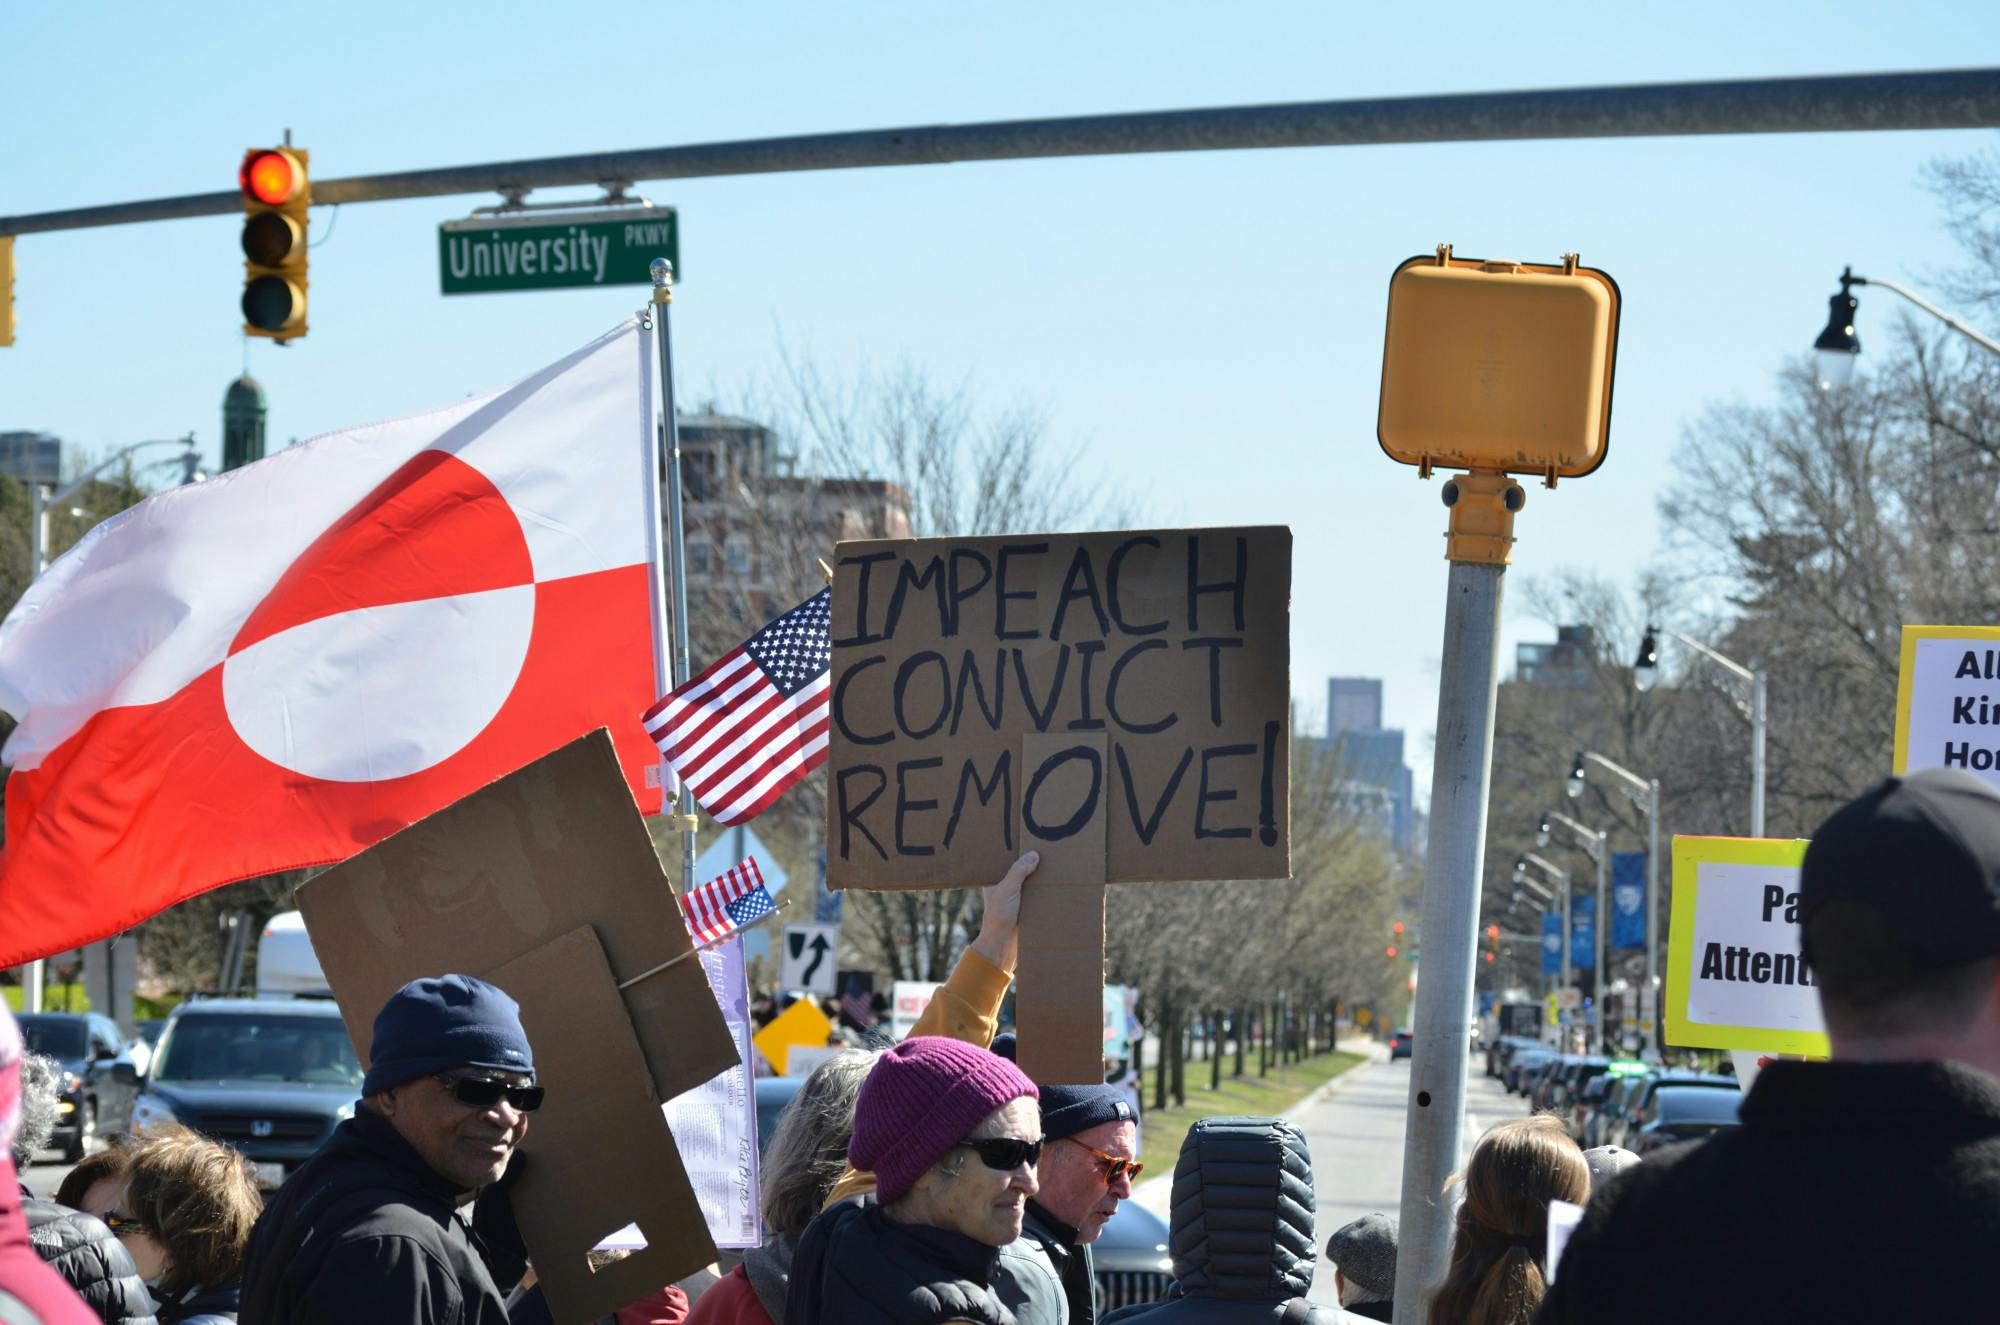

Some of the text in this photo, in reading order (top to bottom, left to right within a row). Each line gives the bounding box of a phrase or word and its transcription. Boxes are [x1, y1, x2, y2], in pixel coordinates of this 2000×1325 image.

[449, 223, 669, 282] University PKWY
[833, 536, 1248, 648] IMPEACH
[833, 639, 1243, 745] CONVICT
[1944, 741, 2000, 771] Ho
[836, 720, 1281, 861] REMOVE!
[1762, 884, 1801, 924] Pa
[1700, 942, 1818, 987] Attent
